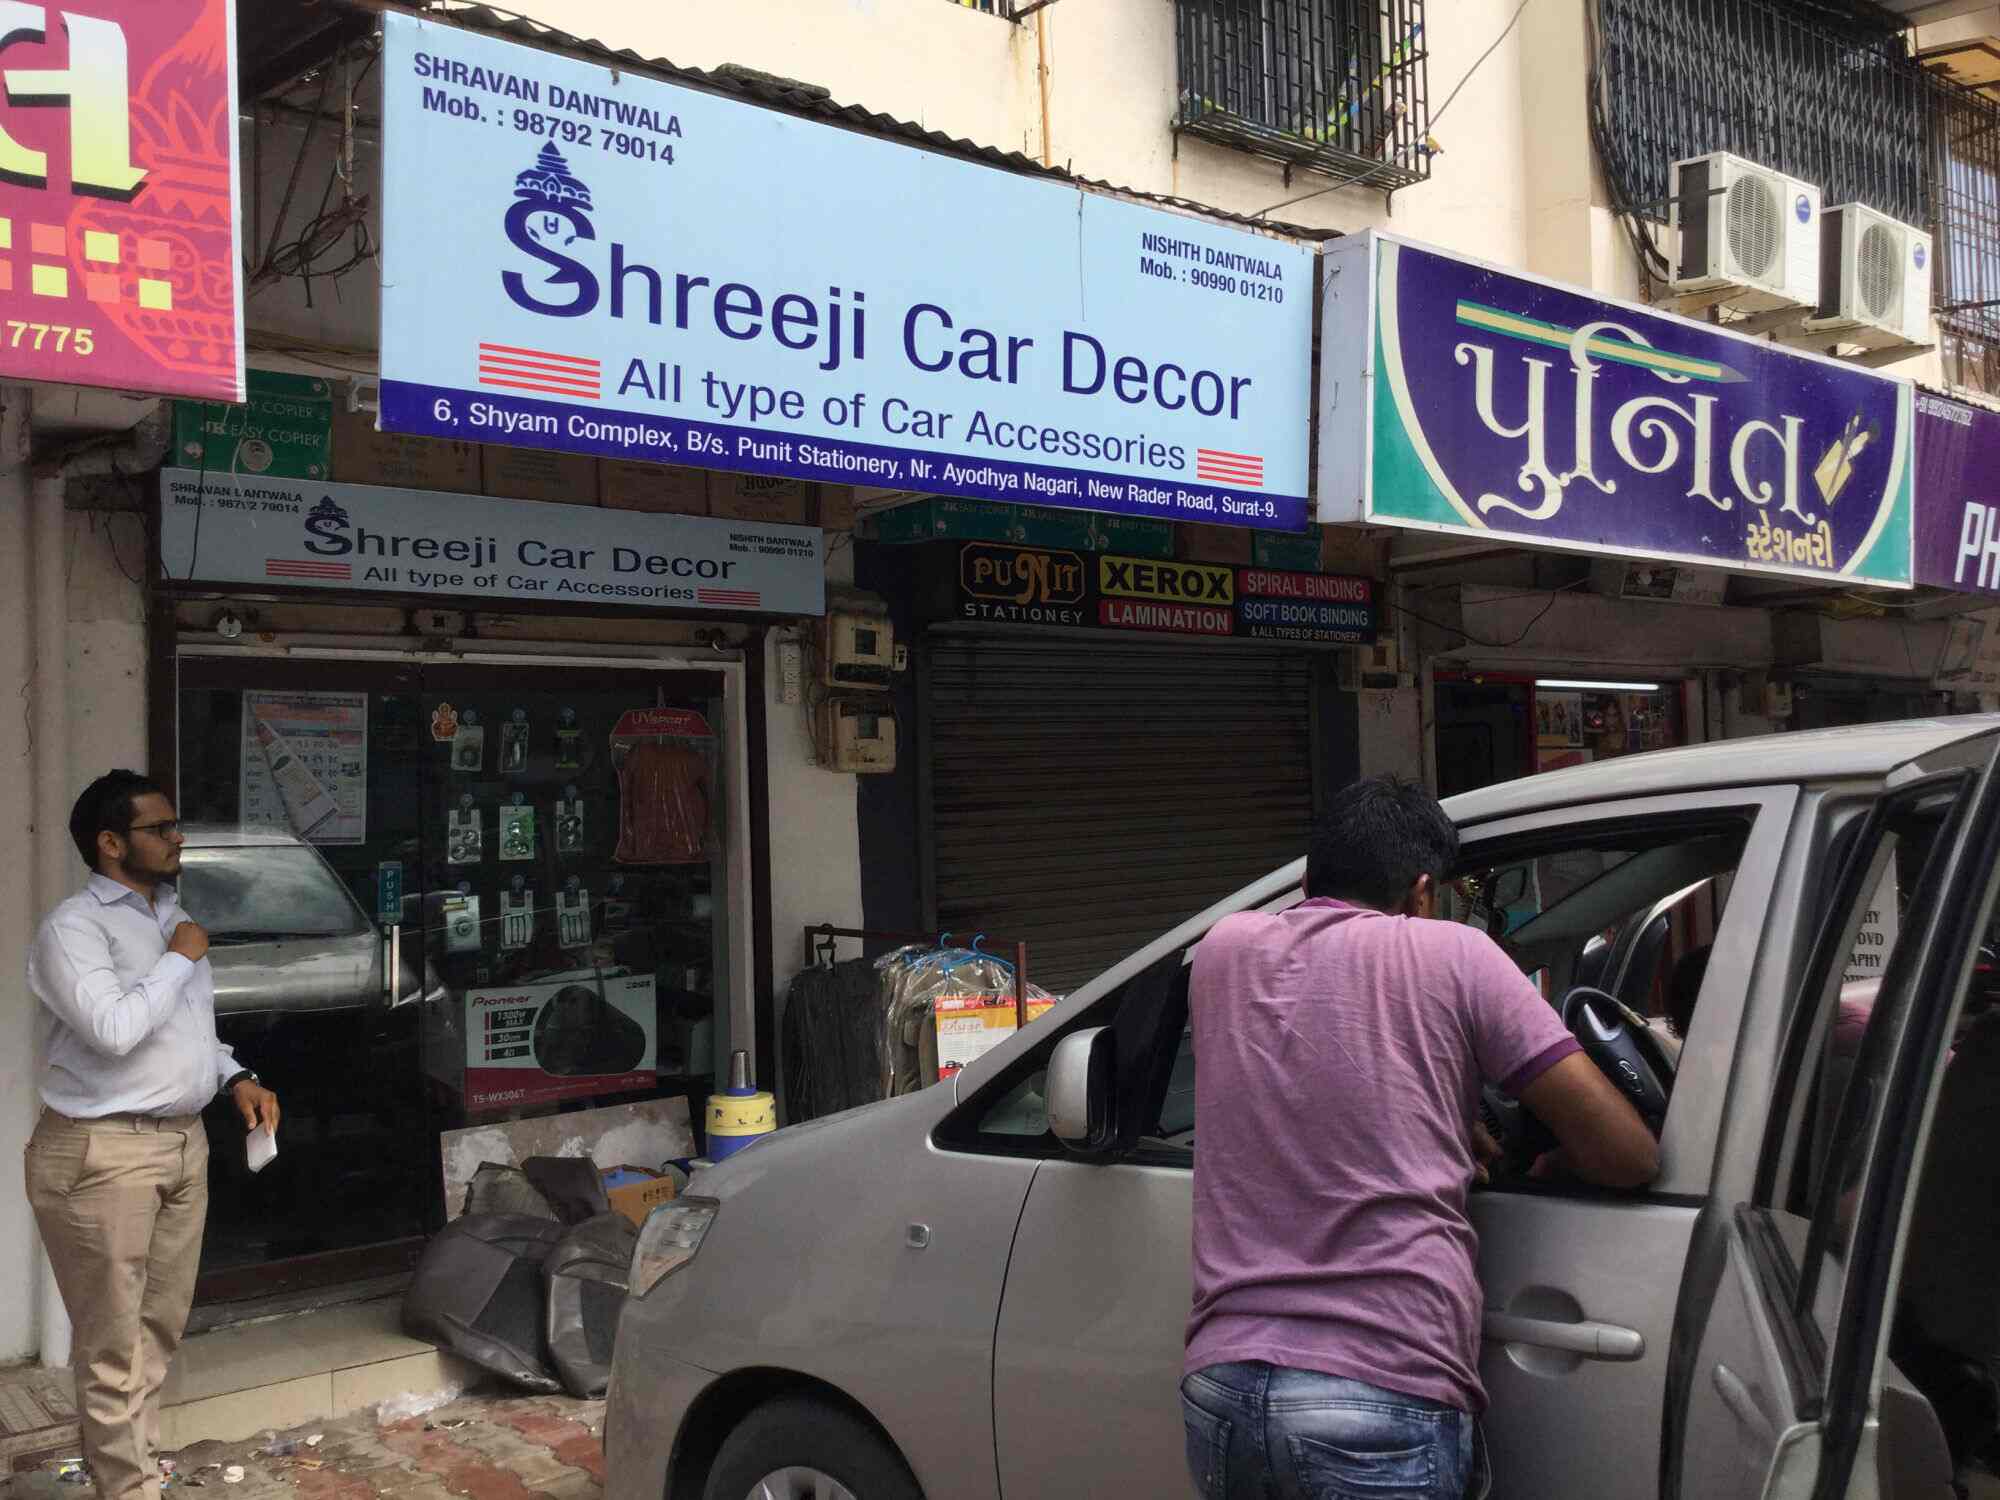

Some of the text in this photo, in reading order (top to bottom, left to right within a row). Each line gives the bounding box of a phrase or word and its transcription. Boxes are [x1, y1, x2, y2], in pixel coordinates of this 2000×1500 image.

[413, 52, 682, 137] SHRAVAN DANTWALA
[423, 86, 487, 123] Mob.
[513, 108, 592, 147] 98792
[600, 128, 675, 165] 79014
[1142, 232, 1282, 281] NISHITH DANTWALA
[1140, 256, 1177, 281] Mob.
[1191, 268, 1236, 294] 90990
[1240, 279, 1283, 304] 01210
[501, 198, 1252, 420] Shreeji Car Decor
[0, 319, 94, 356] 7775
[617, 358, 1185, 471] All type of Car Accessories
[1455, 321, 1816, 525] પુનિત
[433, 399, 1278, 519] 6, Shyam Complex, B/s. Punit Stationery, Nr. Ayodhya Nagari, New Rader Road, Surat-9.
[170, 482, 230, 497] SHRAVAN
[304, 515, 736, 580] Shreeji Car Decor
[1746, 508, 1833, 568] સ્ટેશનરી
[364, 566, 694, 601] All type of Car Accessories
[1105, 561, 1230, 601] XEROX
[1247, 572, 1365, 602] SPIRAL BINDING
[964, 602, 1084, 625] STATIONEY
[1108, 602, 1229, 632] LAMINATION
[1244, 601, 1369, 627] SOFT BOOK BINDING
[1258, 626, 1274, 638] ALL
[1276, 627, 1300, 639] TYPES
[1302, 629, 1313, 640] OF
[1313, 630, 1361, 641] STATIONERY
[471, 993, 532, 1008] Pioneer
